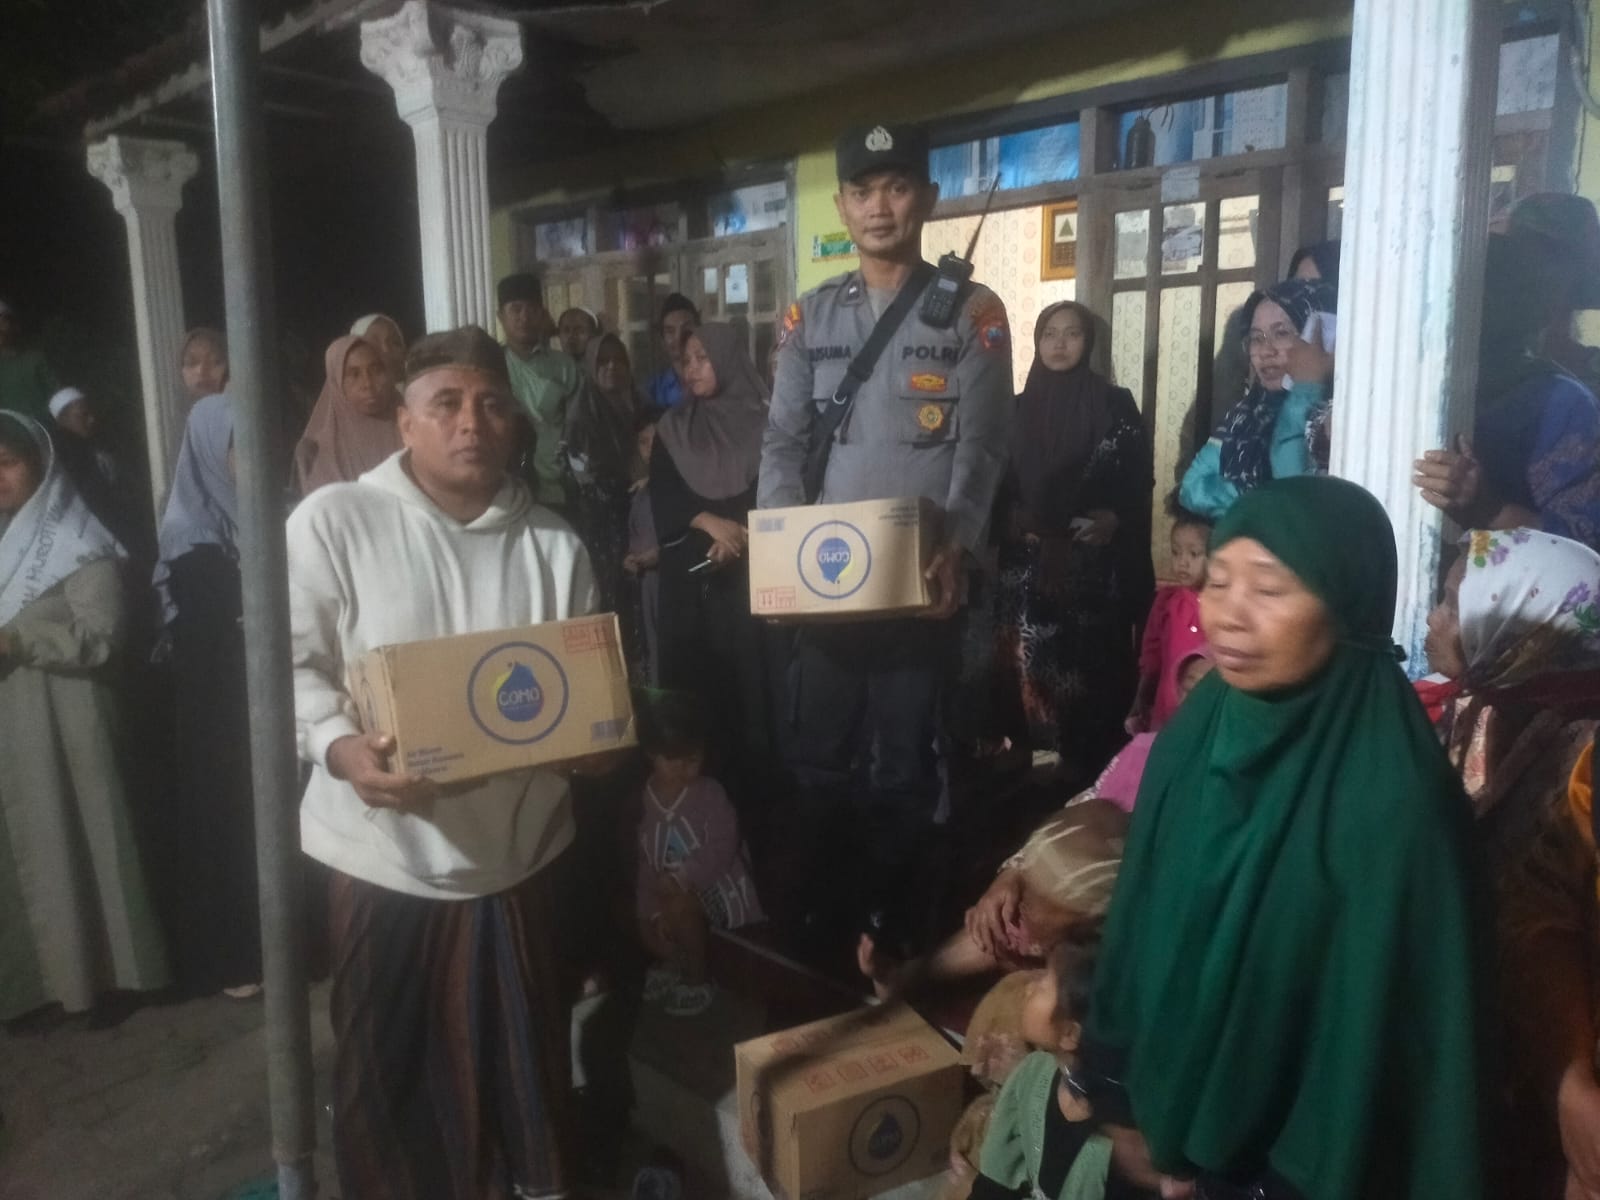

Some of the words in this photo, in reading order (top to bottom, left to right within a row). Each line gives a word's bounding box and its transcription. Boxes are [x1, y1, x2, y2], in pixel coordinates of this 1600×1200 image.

[902, 346, 957, 361] POLRI
[819, 550, 850, 564] COMO
[499, 687, 540, 706] COMO
